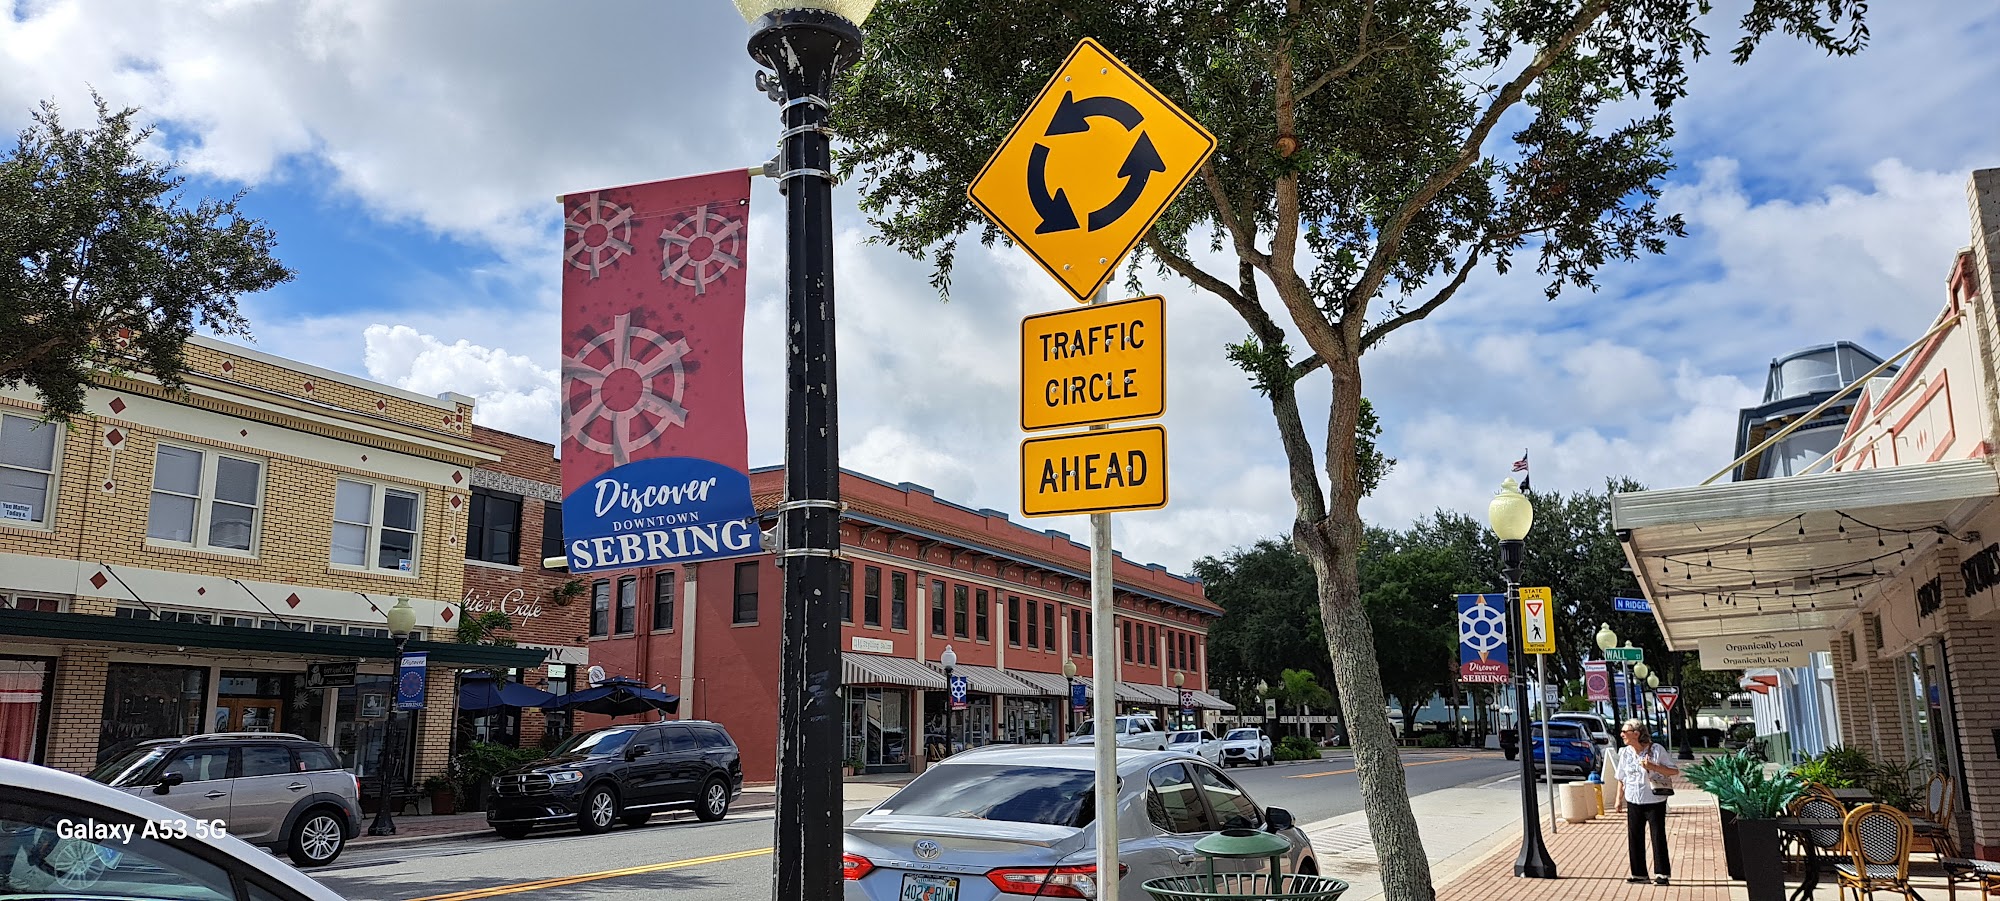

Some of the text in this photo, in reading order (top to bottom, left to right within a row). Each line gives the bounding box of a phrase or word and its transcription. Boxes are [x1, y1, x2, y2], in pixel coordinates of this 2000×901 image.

[1039, 319, 1145, 362] TRAFFIC
[1045, 368, 1138, 408] CIRCLE
[1038, 450, 1147, 494] AHEAD
[594, 476, 717, 518] Discover
[613, 511, 699, 532] DOWNTOWN
[571, 519, 752, 570] SEBRING
[500, 588, 542, 628] Cafe
[1617, 600, 1623, 608] N
[1606, 649, 1627, 660] WALL
[1725, 639, 1804, 652] Organically Local
[1469, 662, 1500, 672] Discover
[1723, 656, 1766, 665] Organically
[1462, 674, 1508, 682] SEBRING
[904, 884, 923, 900] 402
